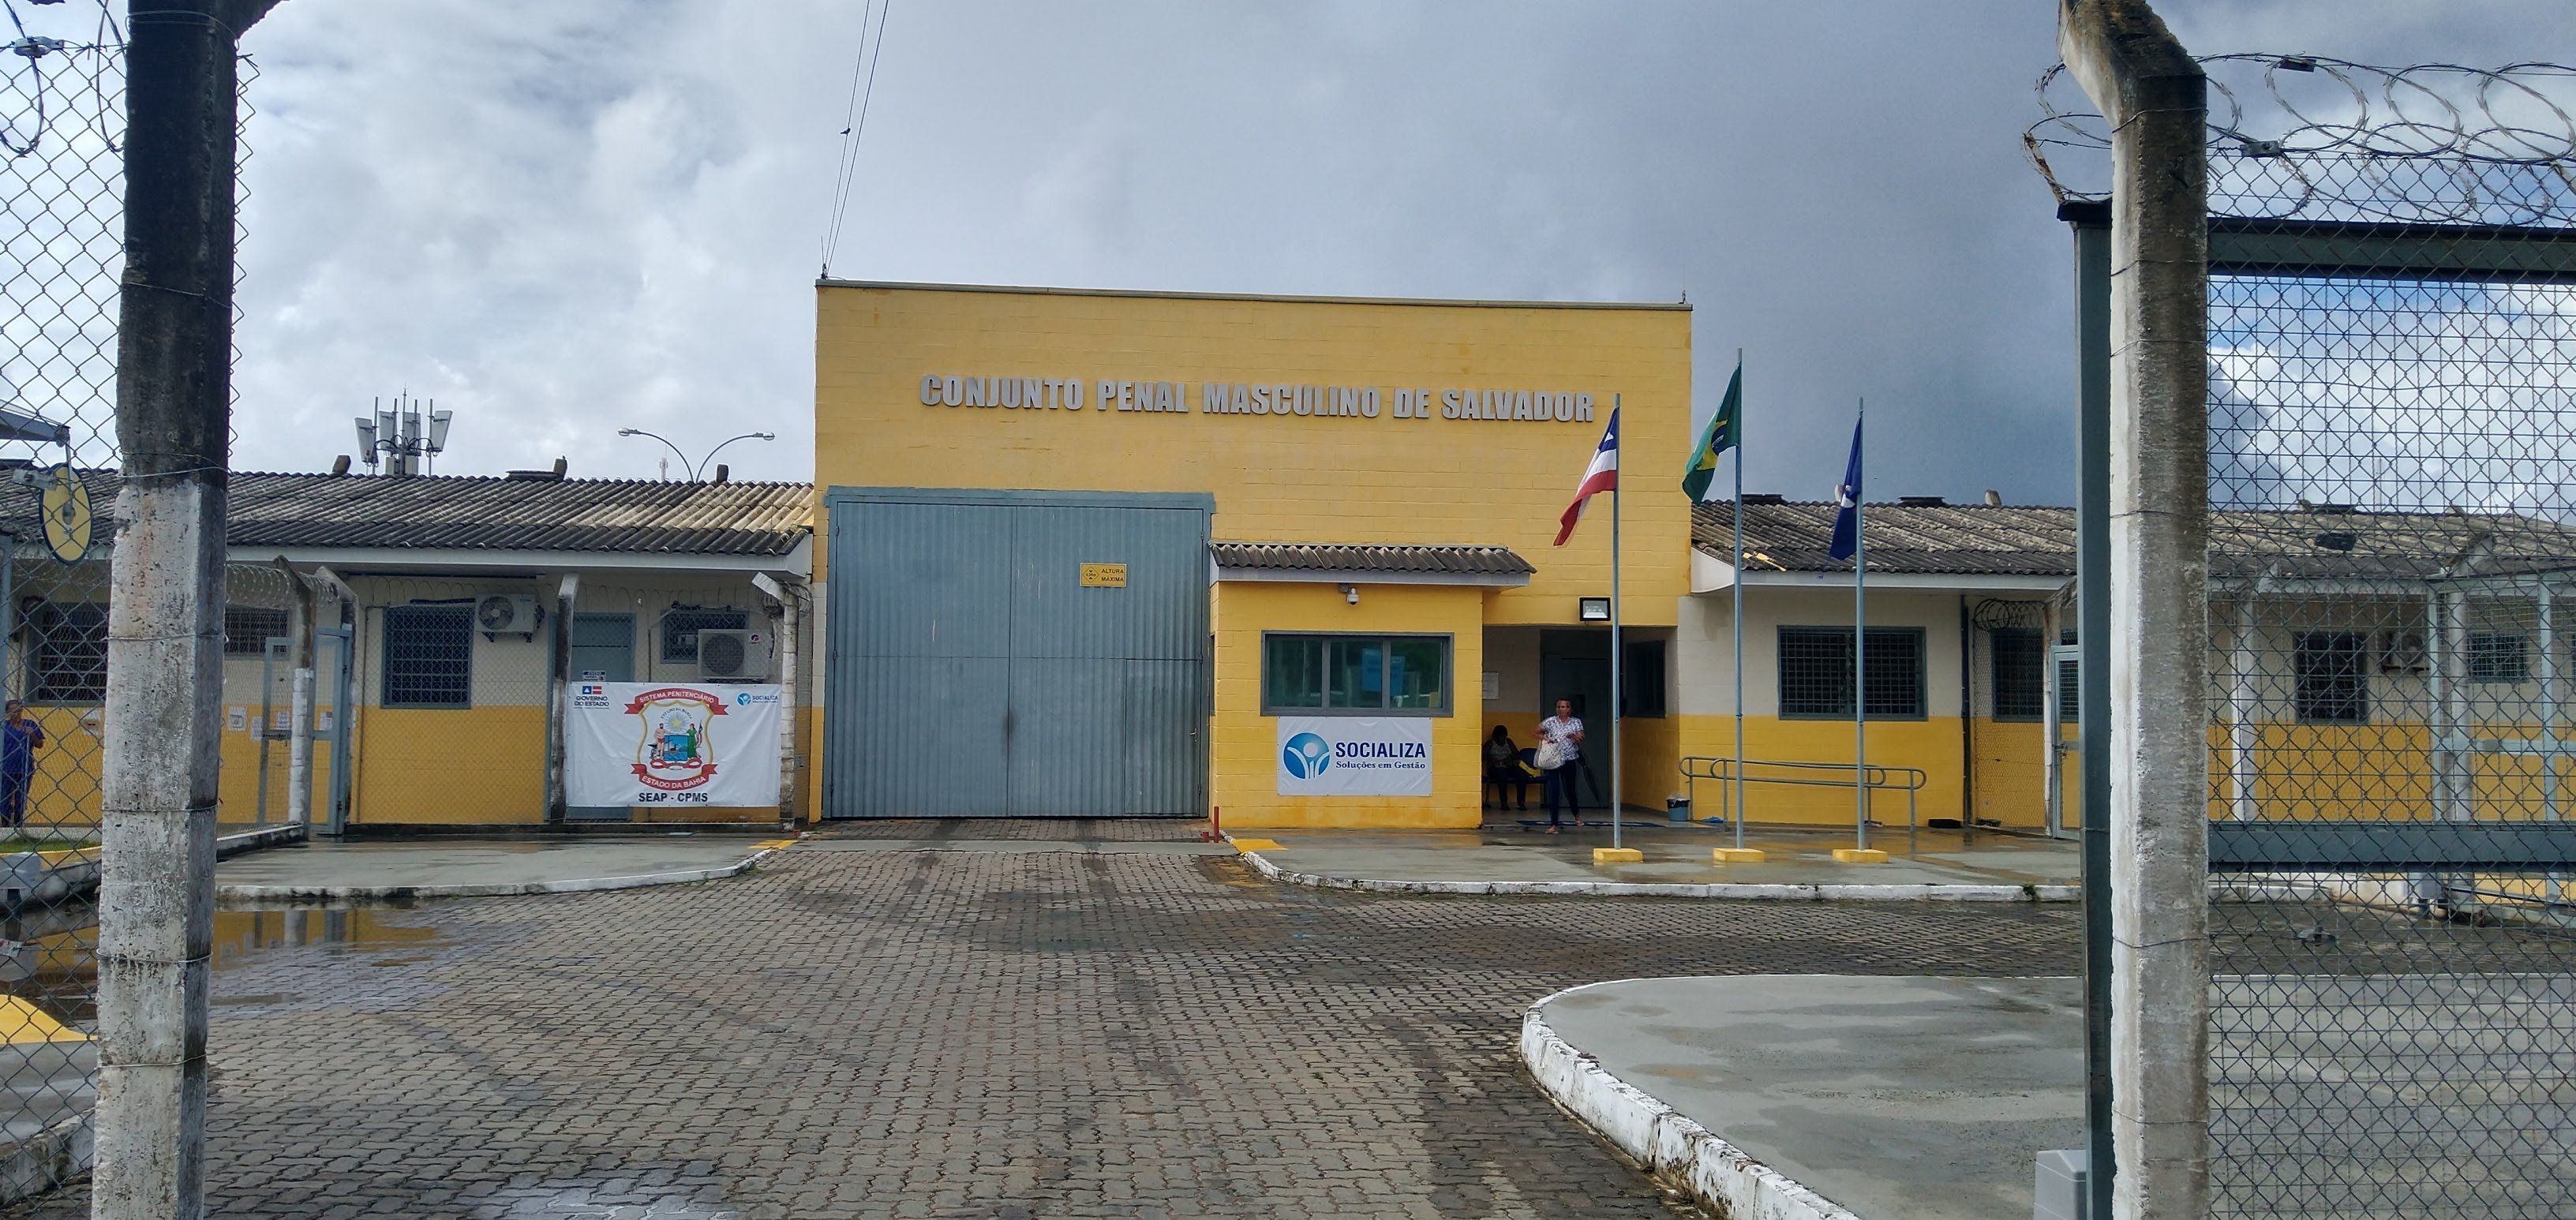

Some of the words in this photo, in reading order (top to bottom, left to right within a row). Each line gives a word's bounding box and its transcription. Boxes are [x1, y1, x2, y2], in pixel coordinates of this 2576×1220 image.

[920, 374, 1084, 410] CONJUNTO
[1097, 380, 1189, 413] PENAL
[1202, 384, 1381, 418] MASCULINO
[1393, 389, 1430, 419] DE
[1442, 389, 1595, 422] SALVADOR
[639, 692, 667, 702] SISTEMA
[667, 690, 714, 703] PENITENCIÁRIO
[1335, 742, 1426, 758] SOCIALIZA
[1335, 761, 1376, 770] Soluções
[642, 776, 670, 788] ESTADO
[683, 776, 706, 788] BAHIA
[638, 792, 668, 803] SEAP
[677, 792, 708, 803] CPMS
